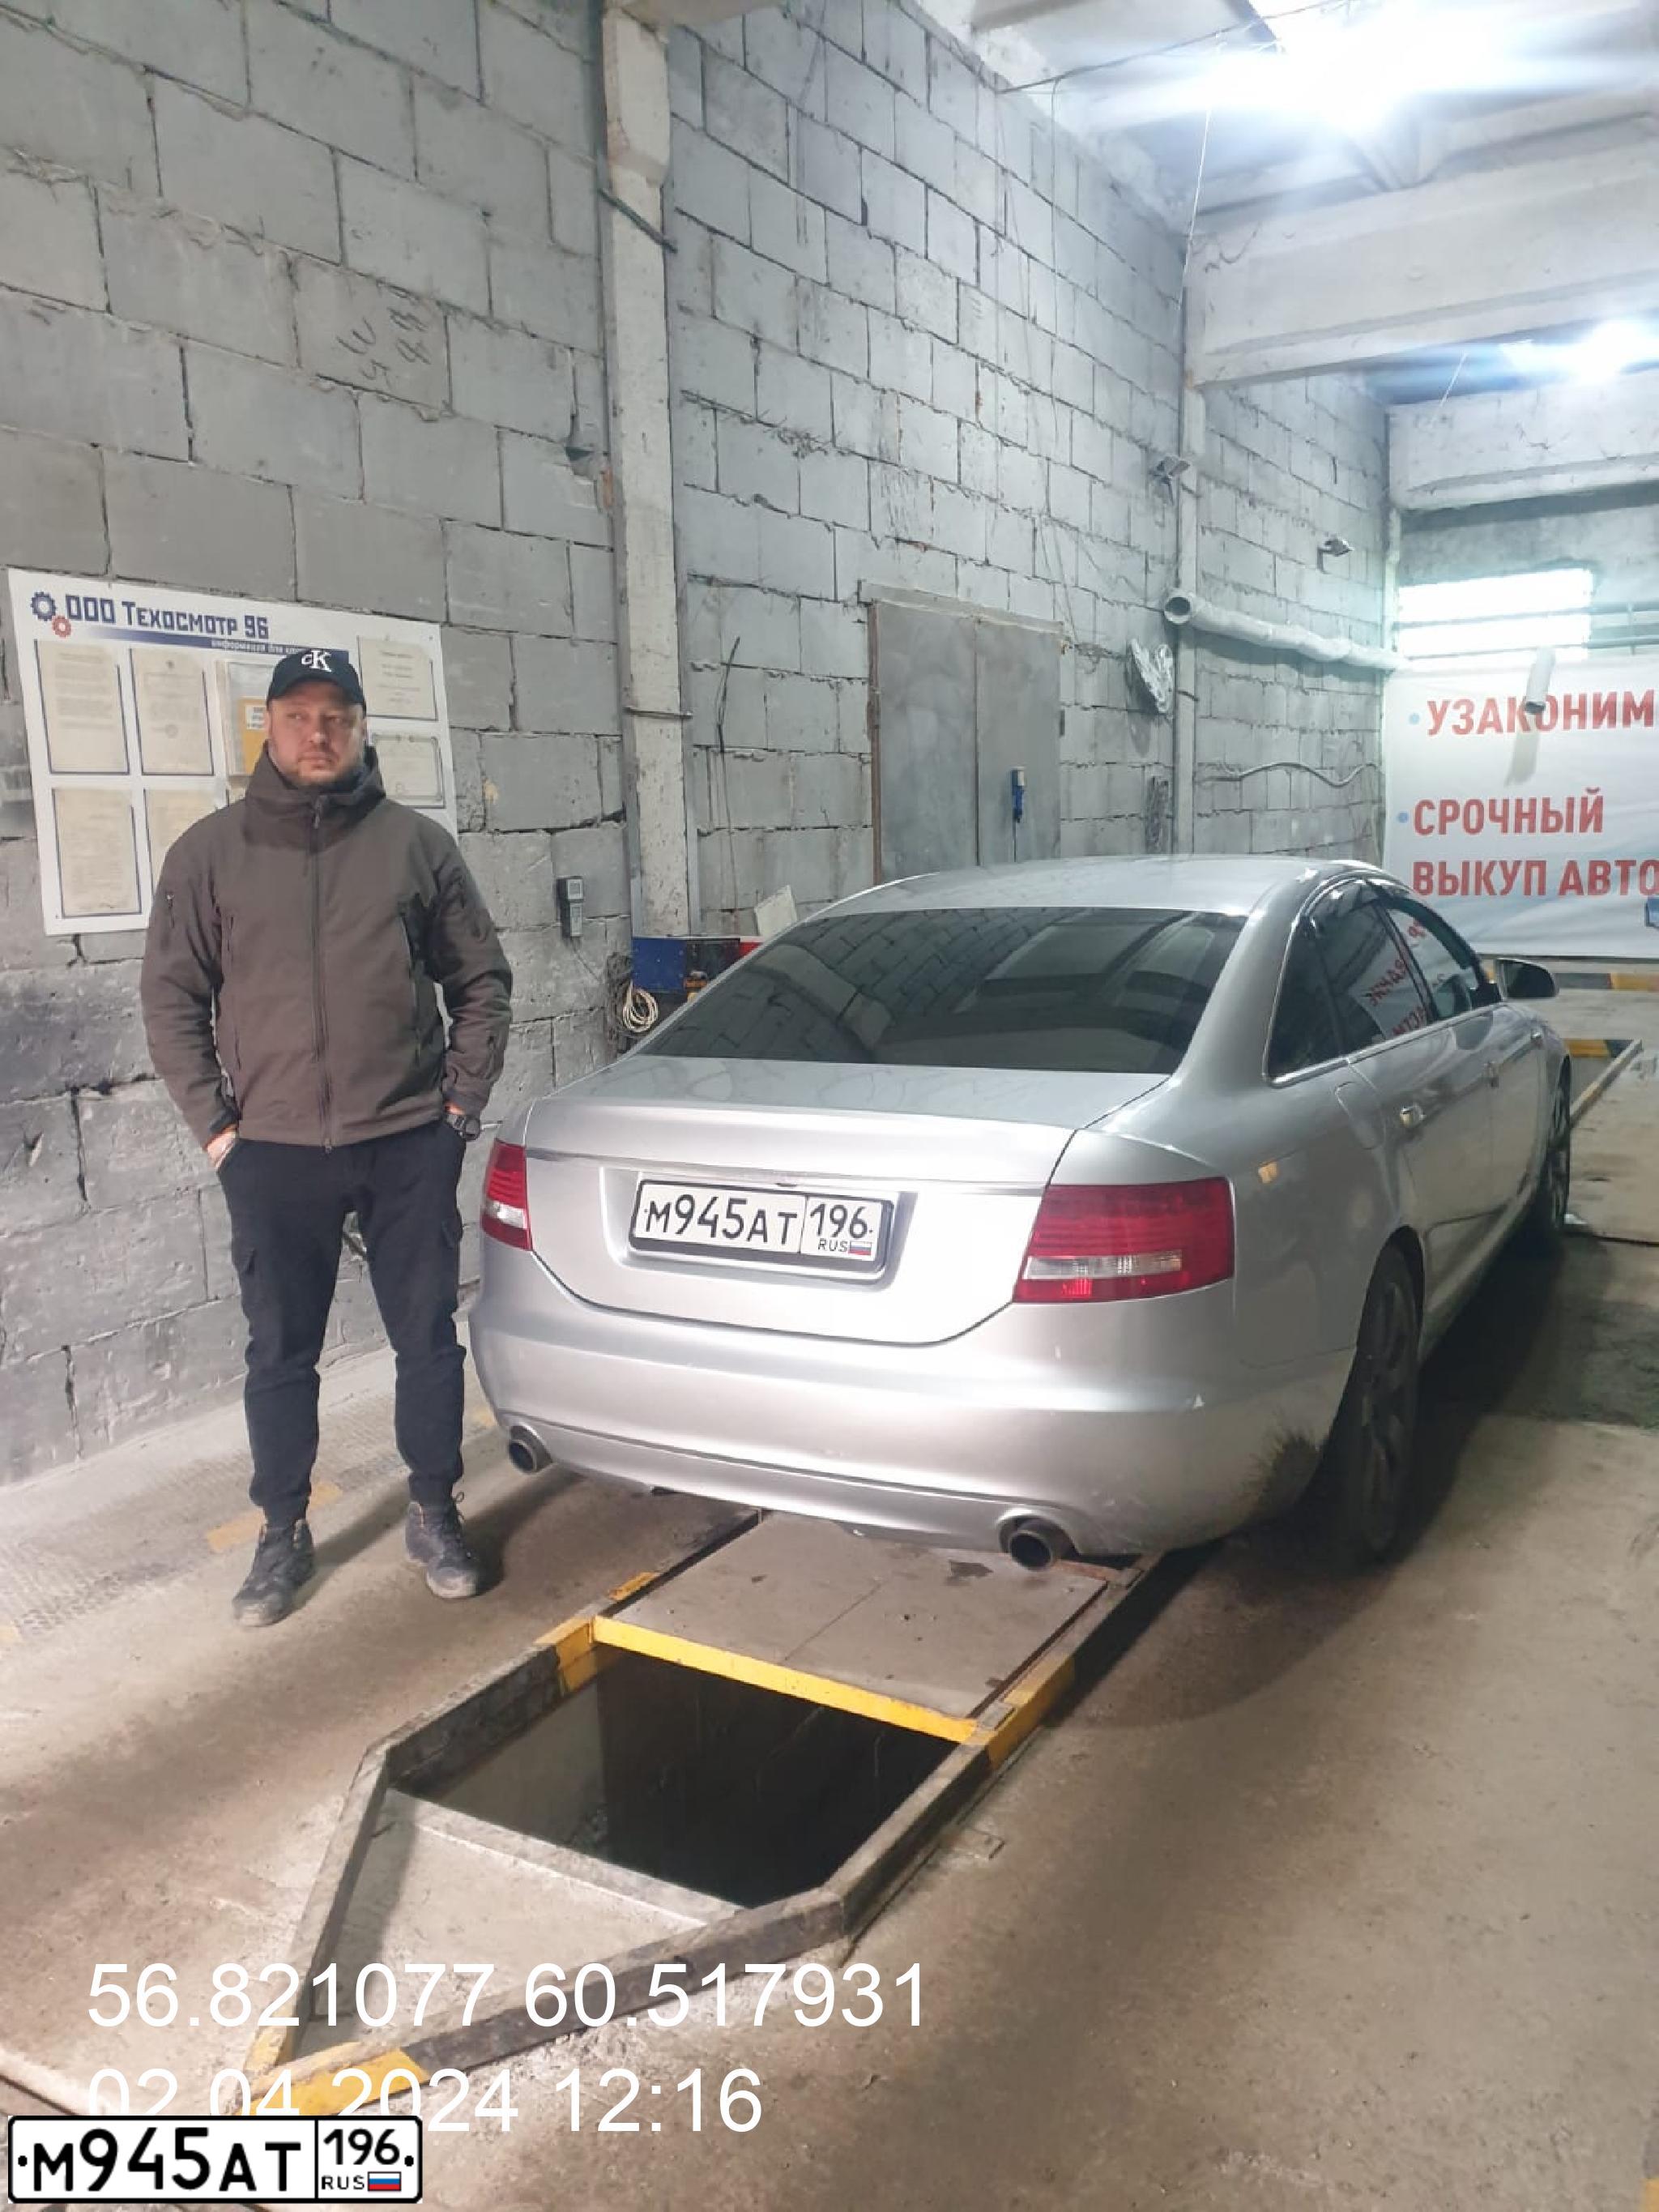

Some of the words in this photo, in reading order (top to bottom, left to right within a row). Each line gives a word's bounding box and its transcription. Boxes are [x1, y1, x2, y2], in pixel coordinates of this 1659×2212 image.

[66, 595, 115, 624] ООО
[245, 615, 268, 639] 96
[1427, 689, 1655, 736] УЗАКОНИМ
[1413, 787, 1604, 835] СРОЧНЫЙ
[1412, 860, 1547, 896] ВЫКУП
[1558, 859, 1659, 896] АВТО
[646, 1194, 798, 1245] М945АТ
[810, 1202, 868, 1239] 196
[817, 1237, 848, 1253] RUS
